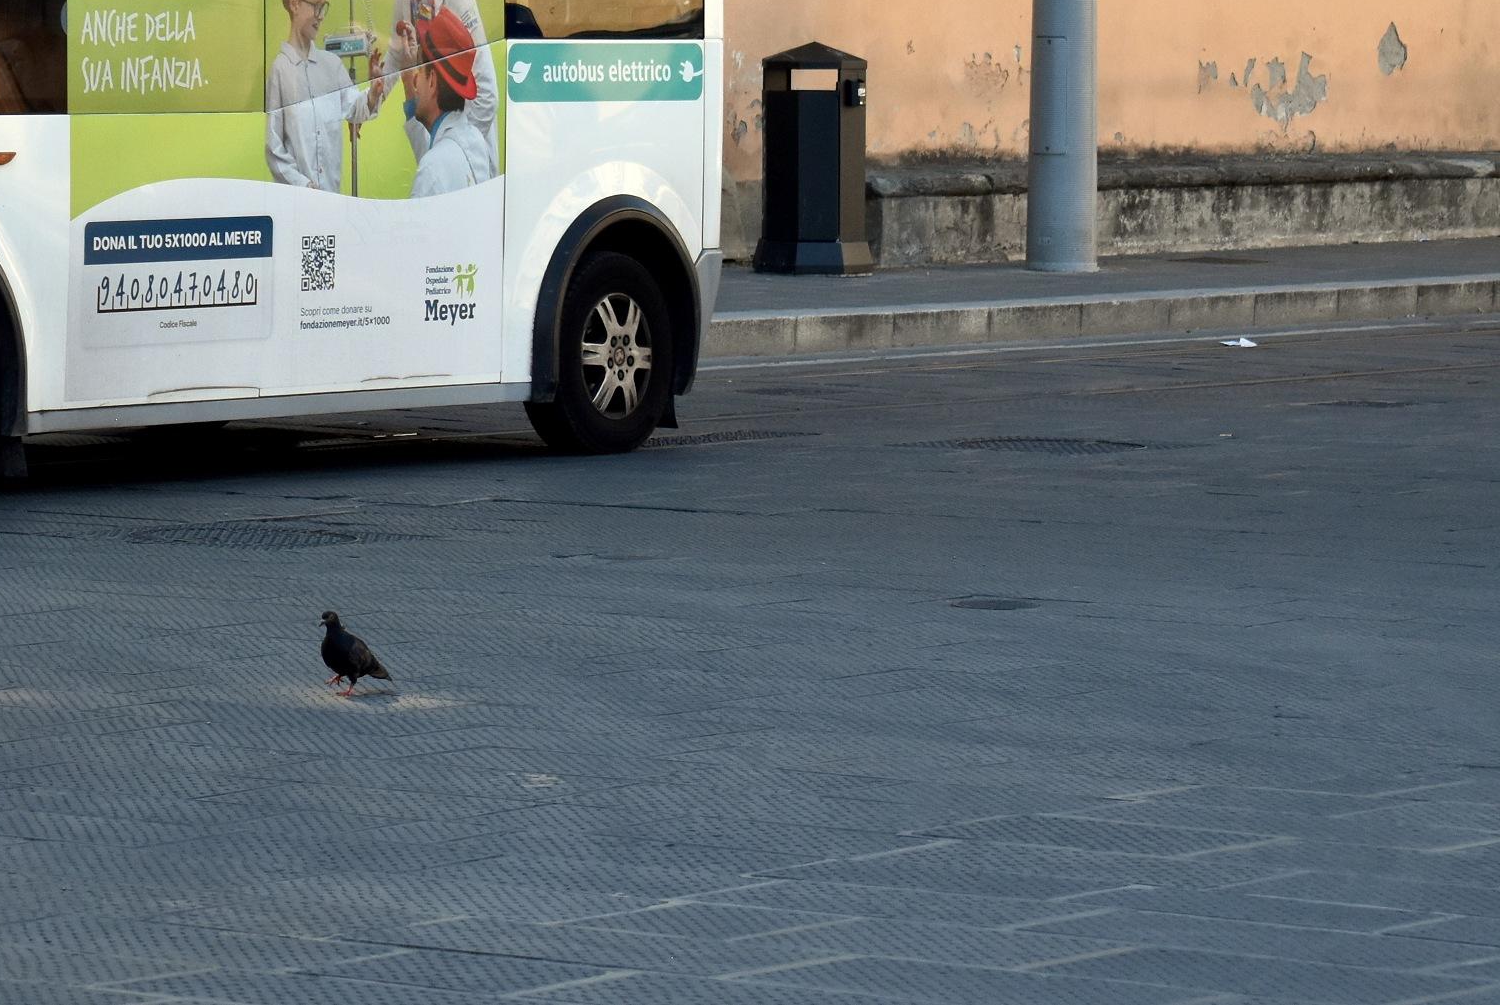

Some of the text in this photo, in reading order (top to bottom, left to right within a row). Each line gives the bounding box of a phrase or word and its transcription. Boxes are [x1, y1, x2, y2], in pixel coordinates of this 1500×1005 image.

[81, 9, 196, 47] ANCHE DELLA
[81, 55, 209, 95] SUA INFANZIA.
[543, 59, 671, 82] autobus elettrico
[93, 230, 261, 251] DONA IL TUO 5X1000 AL MEYER
[425, 265, 454, 273] Fondazione
[425, 276, 449, 286] Ospedale
[425, 287, 452, 295] Pediatrico
[300, 305, 372, 317] Scopri come donare su
[424, 299, 476, 326] Meyer
[159, 319, 197, 329] Codice Fiscale
